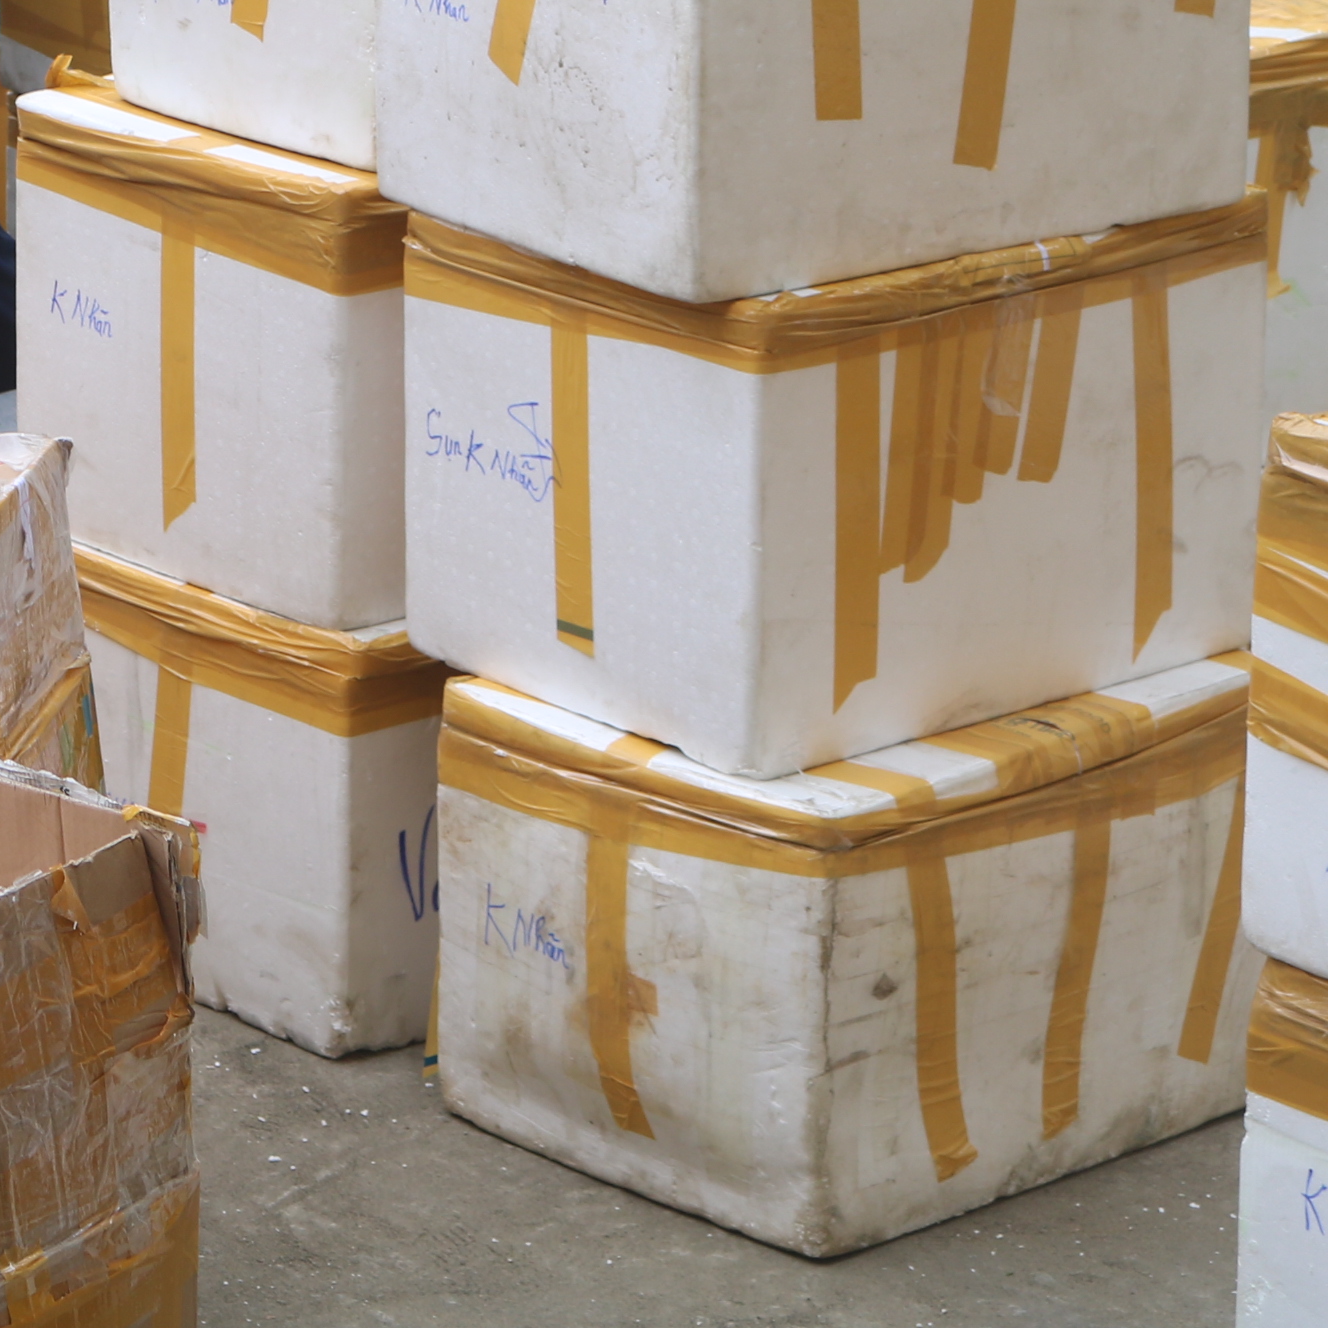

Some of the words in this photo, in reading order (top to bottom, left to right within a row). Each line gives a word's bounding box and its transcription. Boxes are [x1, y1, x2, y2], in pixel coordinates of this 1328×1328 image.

[50, 279, 68, 325] K
[465, 429, 486, 475] K
[484, 882, 514, 959] K
